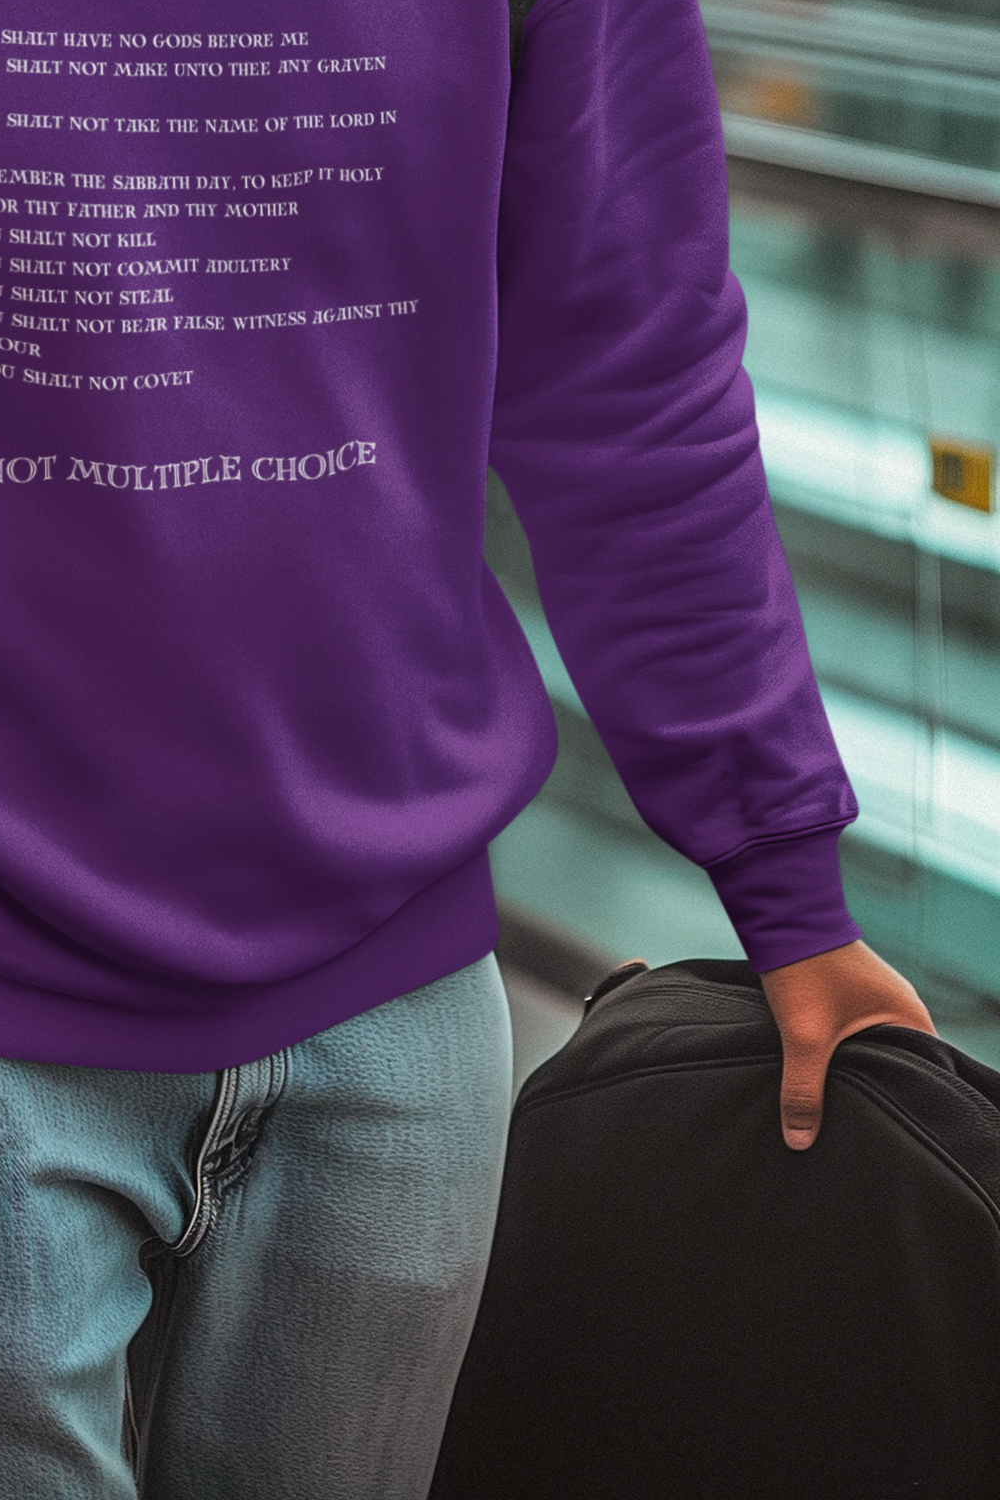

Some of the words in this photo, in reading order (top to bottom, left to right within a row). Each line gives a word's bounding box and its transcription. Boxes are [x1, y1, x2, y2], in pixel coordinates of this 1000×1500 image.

[1, 29, 58, 46] SHALT
[63, 32, 112, 48] HAVE
[119, 34, 147, 48] NO
[152, 34, 202, 48] GODS
[207, 33, 273, 48] BEFORE
[280, 32, 308, 46] ME
[6, 58, 63, 74] SHALT
[68, 61, 107, 76] NOT
[113, 62, 167, 77] MAKE
[174, 62, 223, 77] UNTO
[228, 61, 270, 77] THEE
[277, 59, 311, 74] ANY
[317, 56, 386, 73] GRAVEN
[6, 113, 64, 129] SHALT
[69, 116, 109, 132] NOT
[114, 118, 160, 133] TAKE
[166, 118, 198, 133] THE
[205, 118, 258, 133] NAME
[264, 117, 288, 132] OF
[293, 114, 324, 129] THE
[330, 112, 375, 128] LORD
[380, 110, 397, 125] IN
[71, 173, 106, 189] THE
[113, 175, 190, 190] SABBATH
[196, 176, 236, 191] DAY,
[241, 175, 266, 189] TO
[271, 169, 313, 188] KEEP
[319, 168, 334, 180] IT
[339, 167, 384, 182] HOLY
[24, 199, 60, 216] THY
[67, 202, 137, 219] FATHER
[143, 203, 180, 218] AND
[185, 203, 218, 217] THY
[224, 201, 299, 218] MOTHER
[9, 228, 66, 246] SHALT
[72, 232, 111, 248] NOT
[117, 232, 156, 248] KILL
[10, 258, 66, 275] SHALT
[72, 262, 111, 277] NOT
[117, 258, 199, 276] COMMIT
[205, 257, 291, 273] ADULTERY
[11, 286, 68, 303] SHALT
[74, 290, 113, 305] NOT
[119, 288, 174, 305] STEAL
[11, 313, 70, 332] SHALT
[76, 319, 115, 334] NOT
[121, 317, 168, 333] BEAR
[173, 315, 225, 330] FALSE
[232, 311, 307, 330] WITNESS
[312, 304, 383, 325] AGAINST
[387, 299, 418, 316] THY
[23, 368, 83, 389] SHALT
[89, 376, 128, 390] NOT
[133, 370, 194, 390] COVET
[66, 455, 242, 491] MULTIPLE
[251, 440, 377, 481] CHOICE
